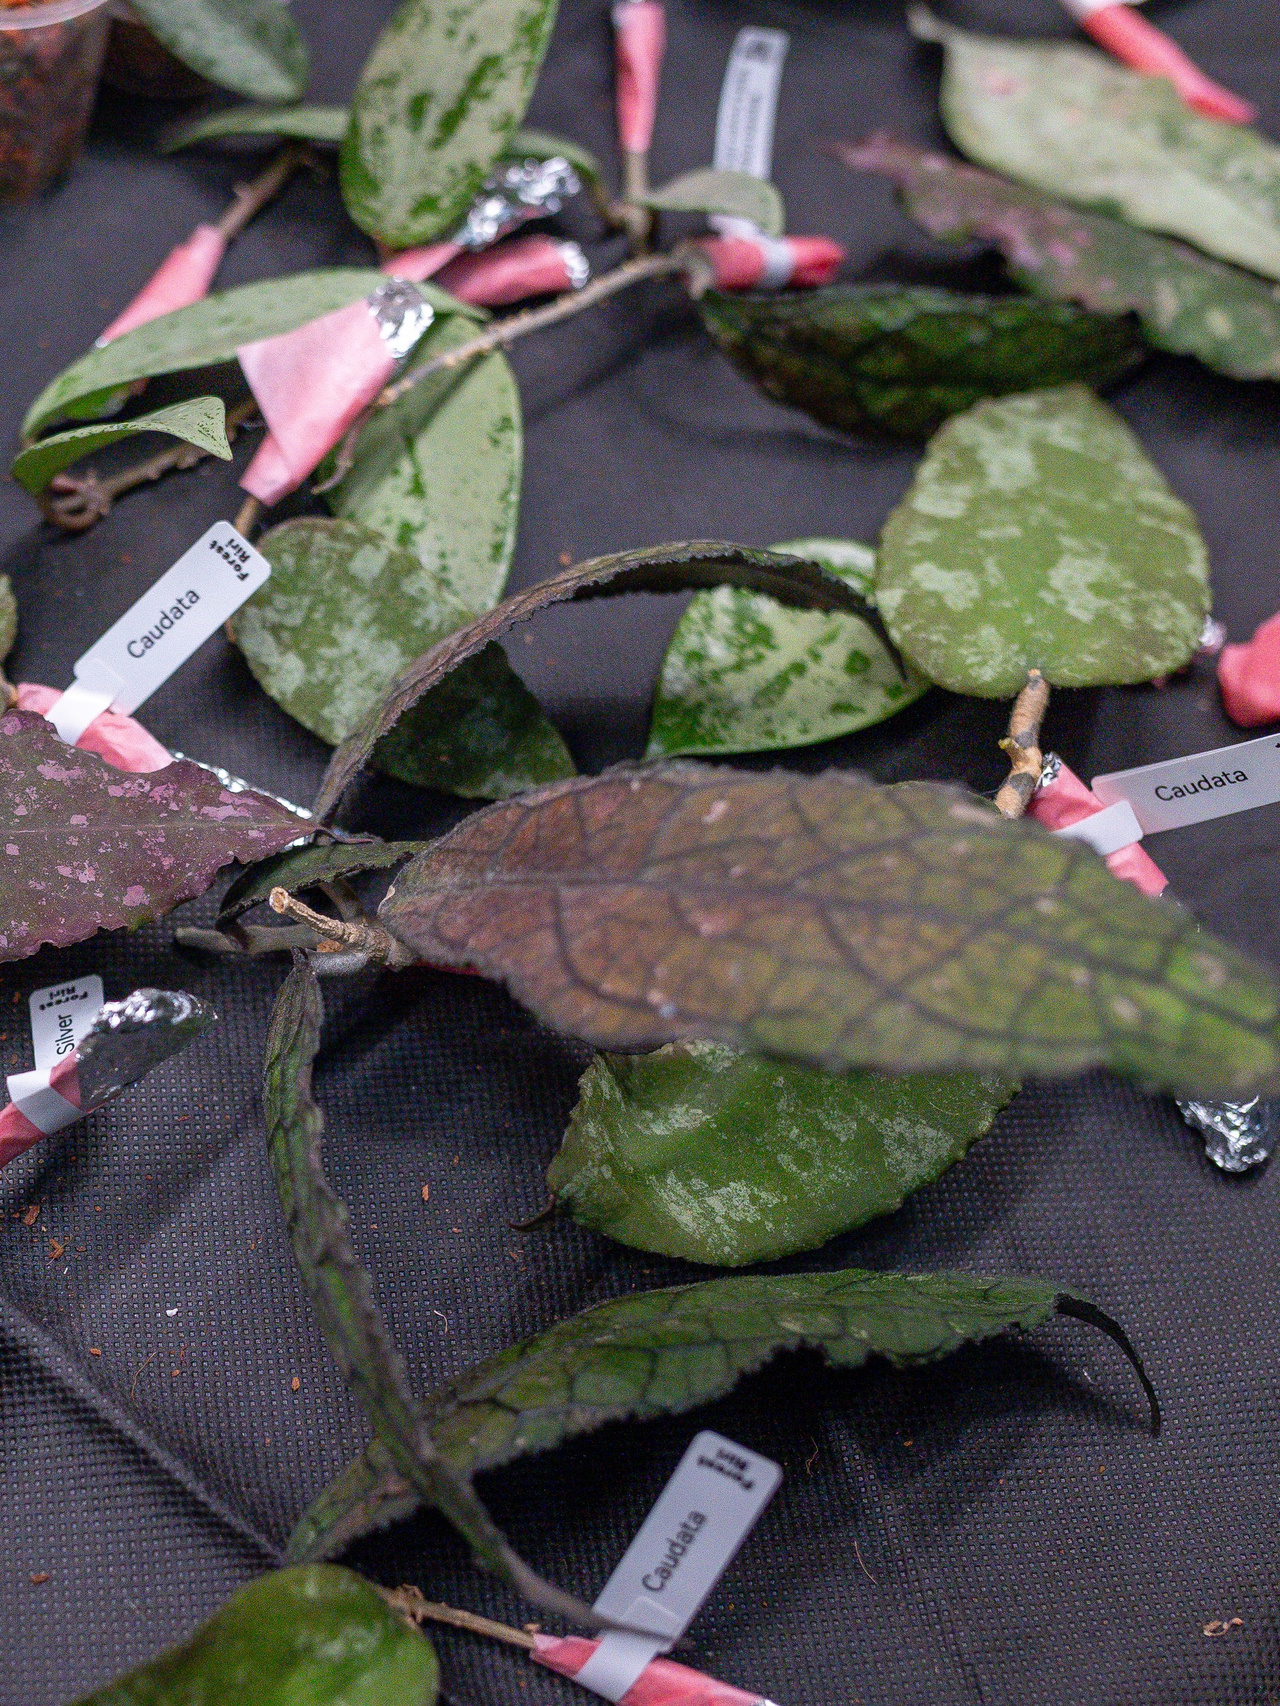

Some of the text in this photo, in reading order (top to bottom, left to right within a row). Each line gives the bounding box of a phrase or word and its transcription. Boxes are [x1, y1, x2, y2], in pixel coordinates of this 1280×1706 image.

[209, 539, 250, 582] Forest
[224, 538, 252, 563] Riri
[127, 589, 201, 659] Caudata
[1154, 769, 1249, 802] Caudata
[39, 990, 89, 1011] Forest
[55, 1014, 75, 1055] Silver
[641, 1509, 707, 1593] Caudata
